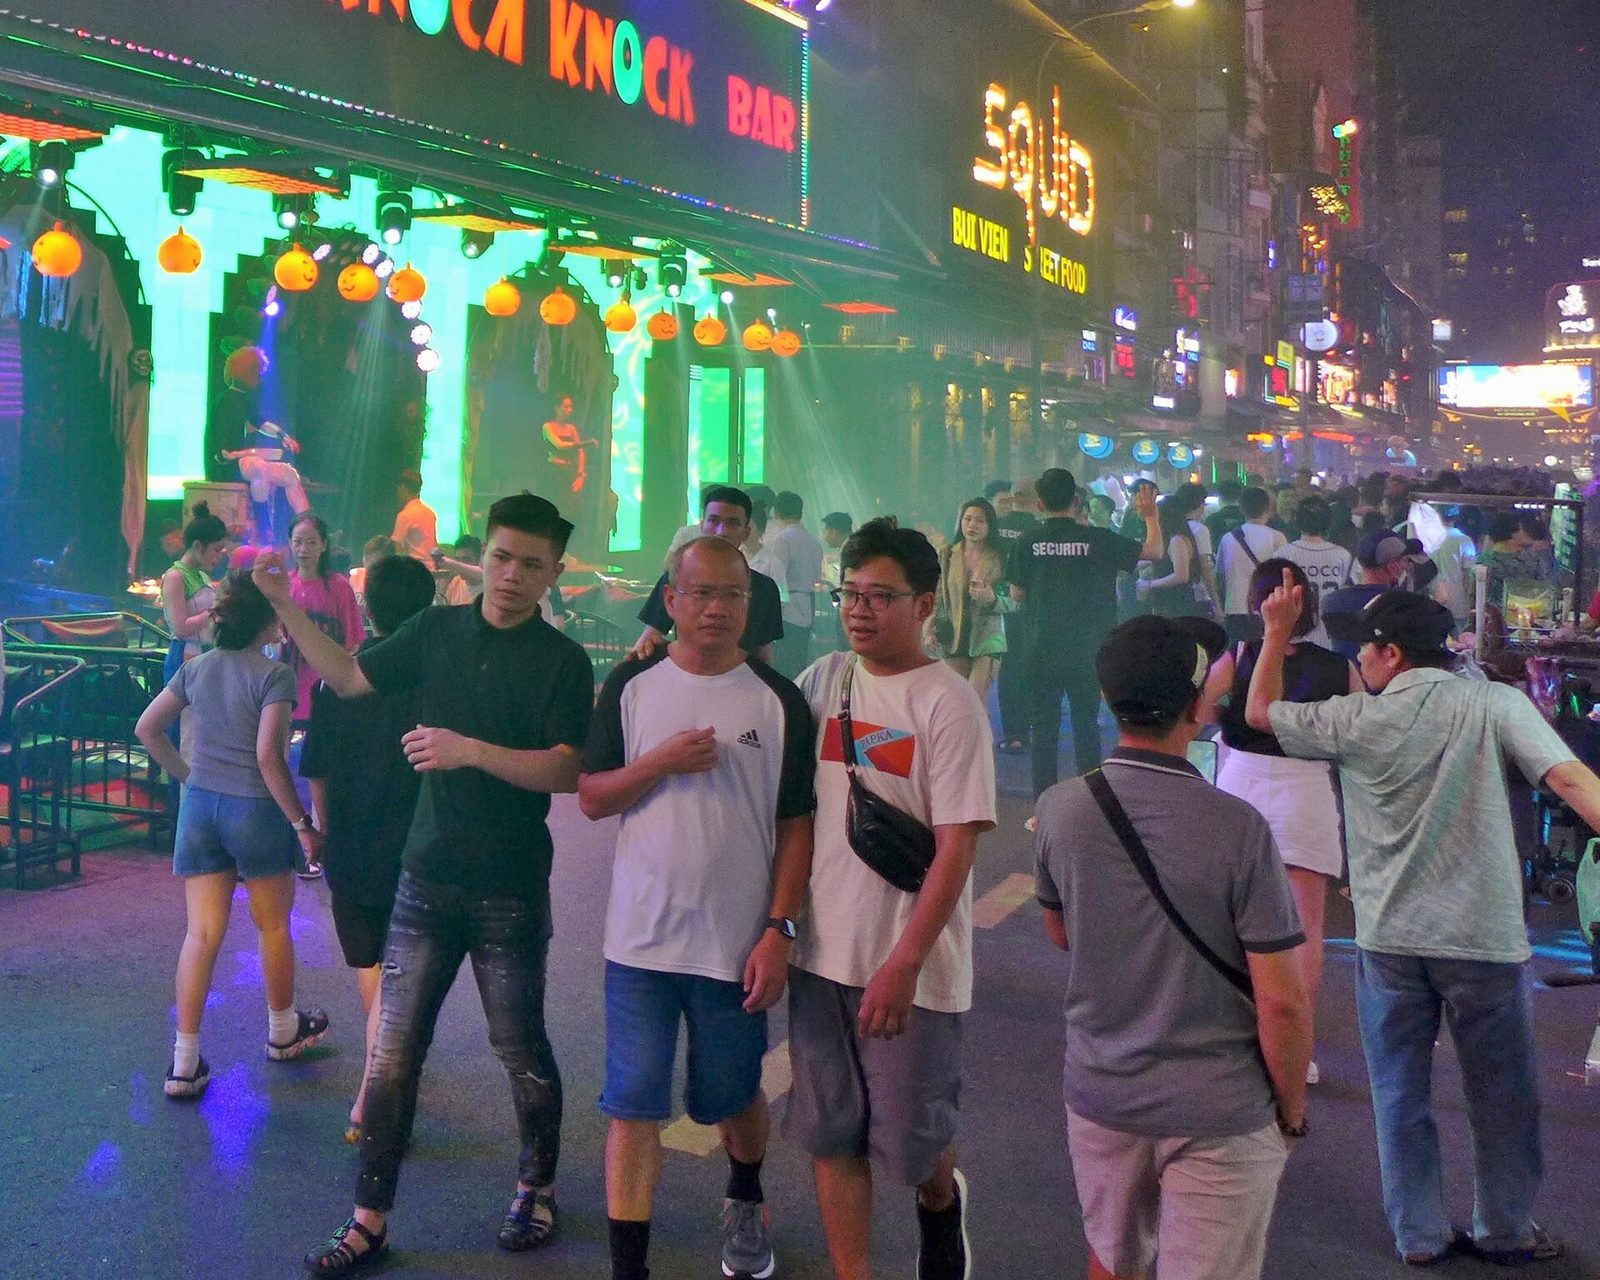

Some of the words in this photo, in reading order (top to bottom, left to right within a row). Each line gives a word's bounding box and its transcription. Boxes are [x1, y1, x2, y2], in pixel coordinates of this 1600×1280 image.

[549, 0, 696, 127] KNOCK
[727, 74, 796, 154] BAR
[952, 206, 977, 251] BUI
[978, 216, 1008, 263] VIEN
[1023, 244, 1060, 285] SEET
[1060, 255, 1086, 294] FOOD
[1032, 542, 1090, 556] SECURITY
